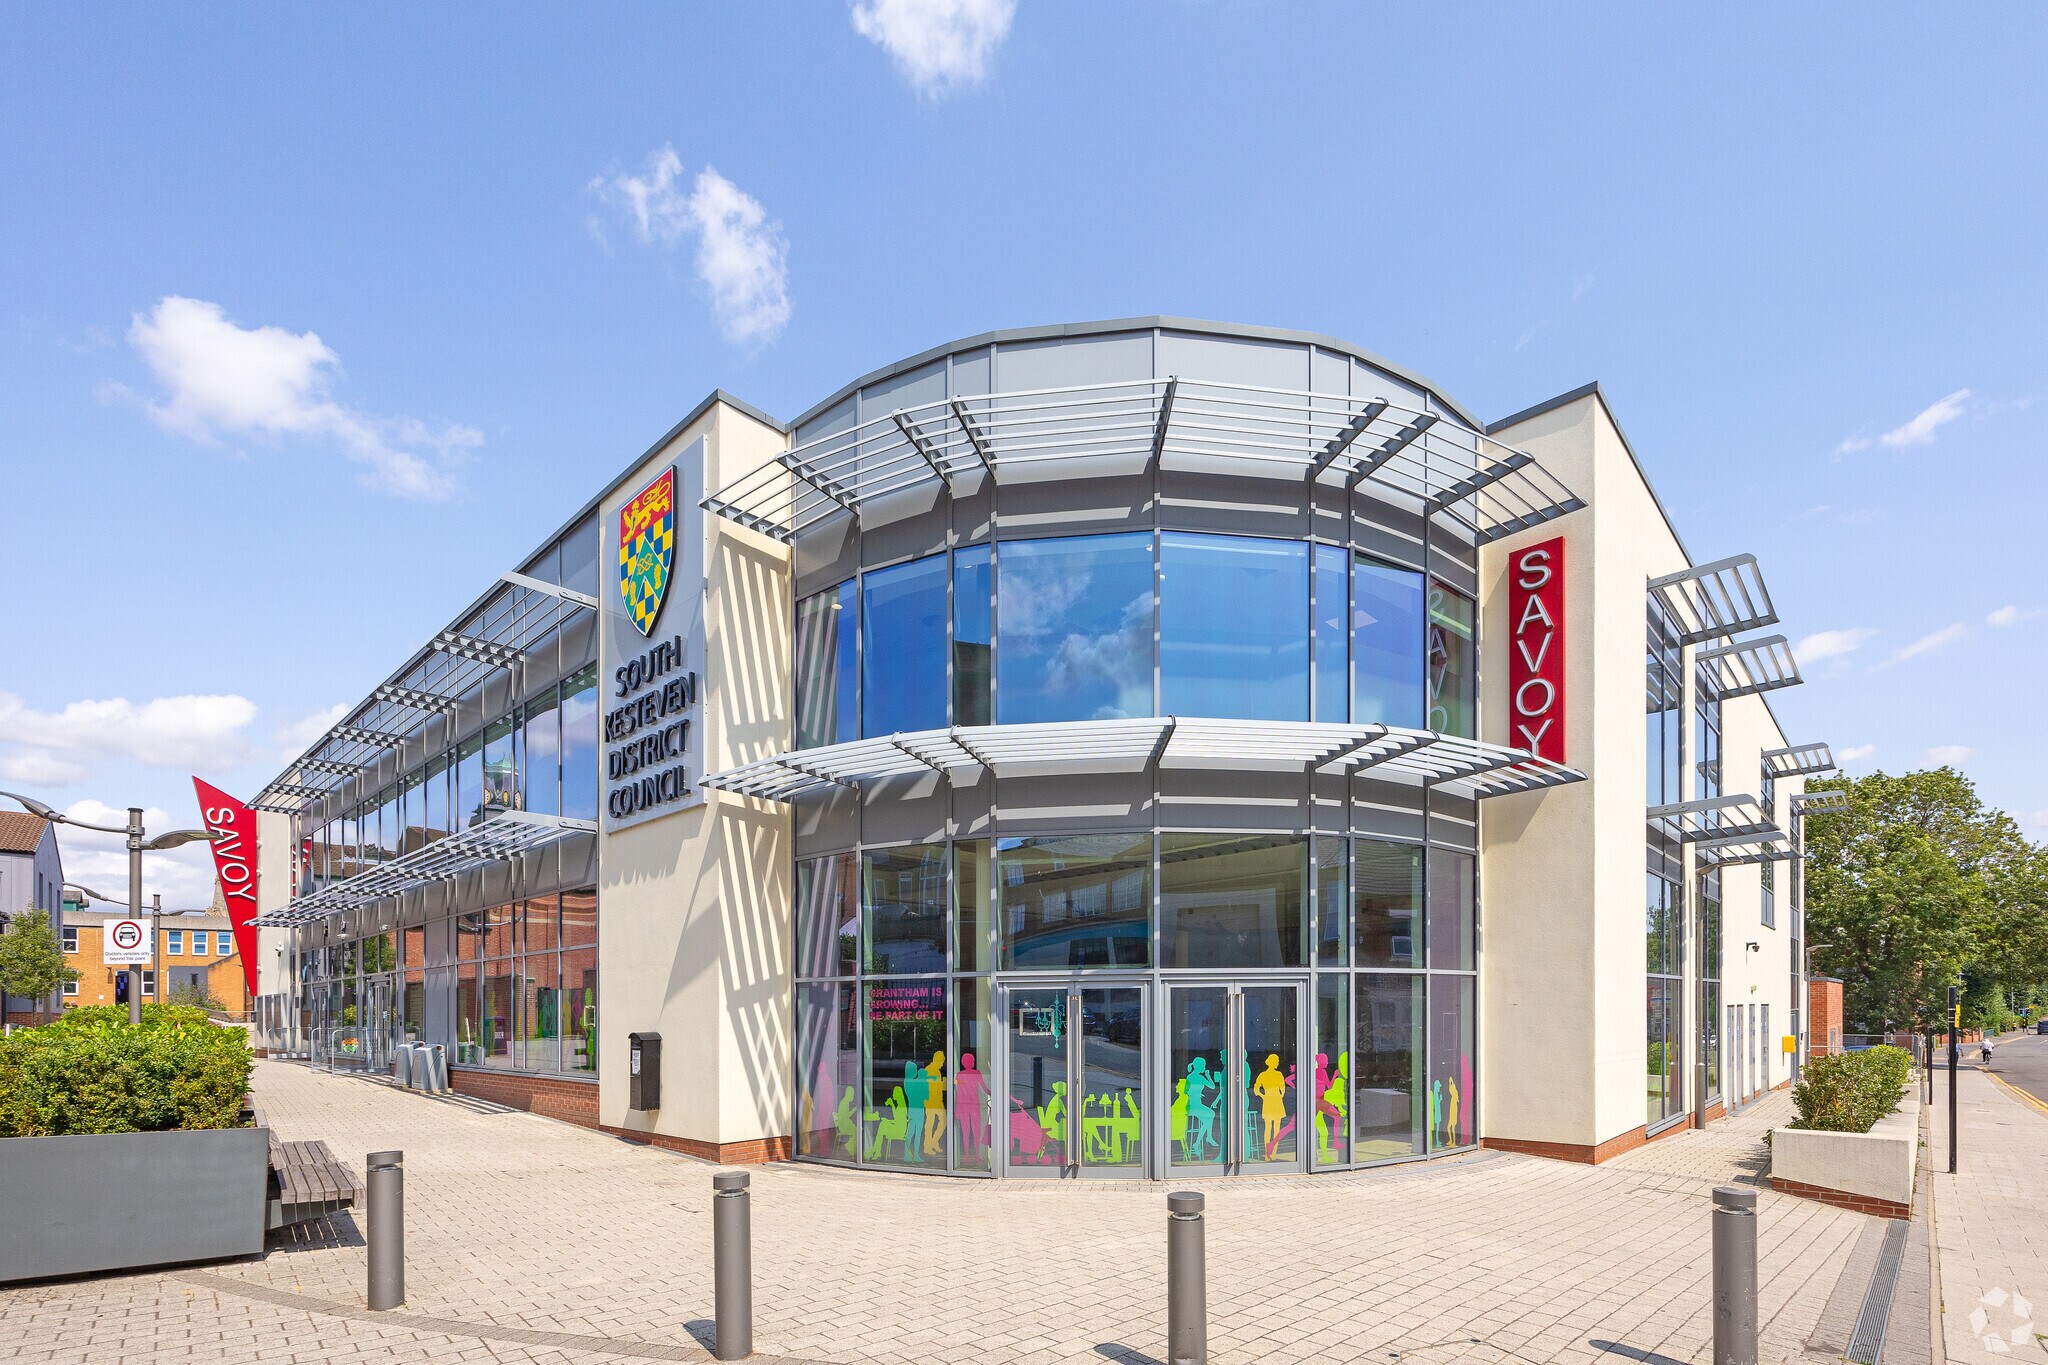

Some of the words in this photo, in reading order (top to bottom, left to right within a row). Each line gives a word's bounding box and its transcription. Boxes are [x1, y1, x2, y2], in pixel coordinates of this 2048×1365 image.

[615, 635, 682, 697] SOUTH
[1516, 550, 1555, 755] SAVOY
[605, 671, 696, 743] KESTEVEN
[609, 718, 690, 780] DISTRICT
[608, 765, 691, 818] COUNCIL
[206, 807, 257, 901] SAVOY
[869, 987, 928, 998] GRANTHAM
[931, 987, 943, 996] IS
[869, 1011, 882, 1020] BE
[886, 1011, 912, 1020] PART
[915, 1010, 930, 1020] OF
[932, 1010, 943, 1020] IT
